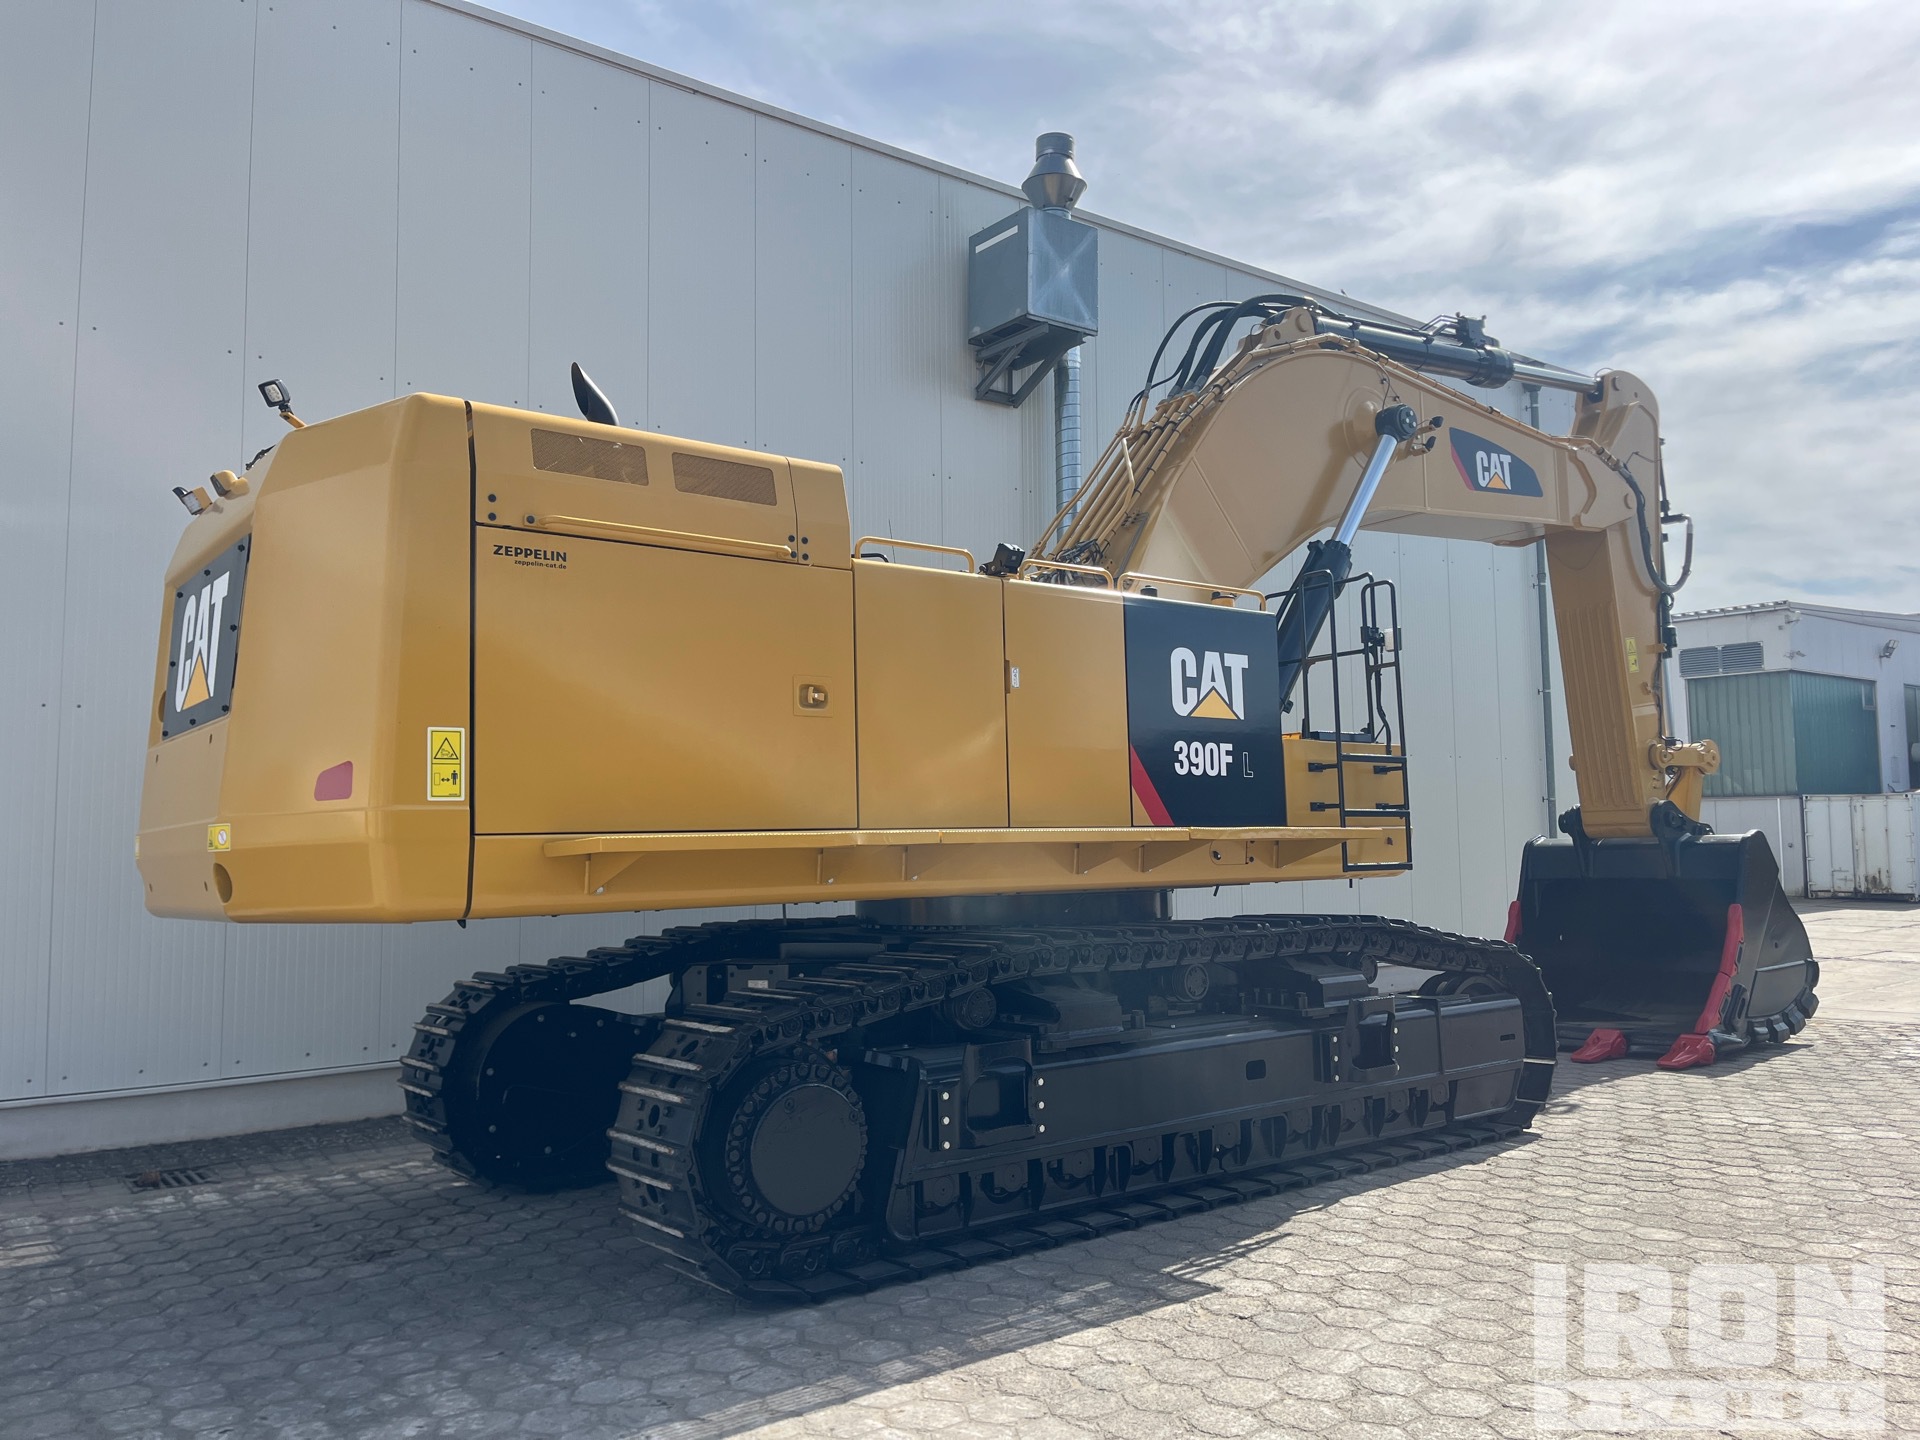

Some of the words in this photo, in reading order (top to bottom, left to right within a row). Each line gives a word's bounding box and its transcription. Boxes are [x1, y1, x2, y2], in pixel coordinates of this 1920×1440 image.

[1476, 450, 1512, 490] CAT
[493, 544, 567, 562] ZEPPELIN
[514, 559, 567, 570] zeppelin-cat.de
[175, 571, 230, 712] CAT
[1170, 647, 1249, 720] CAT
[1174, 740, 1233, 777] 390F
[1242, 752, 1254, 778] L
